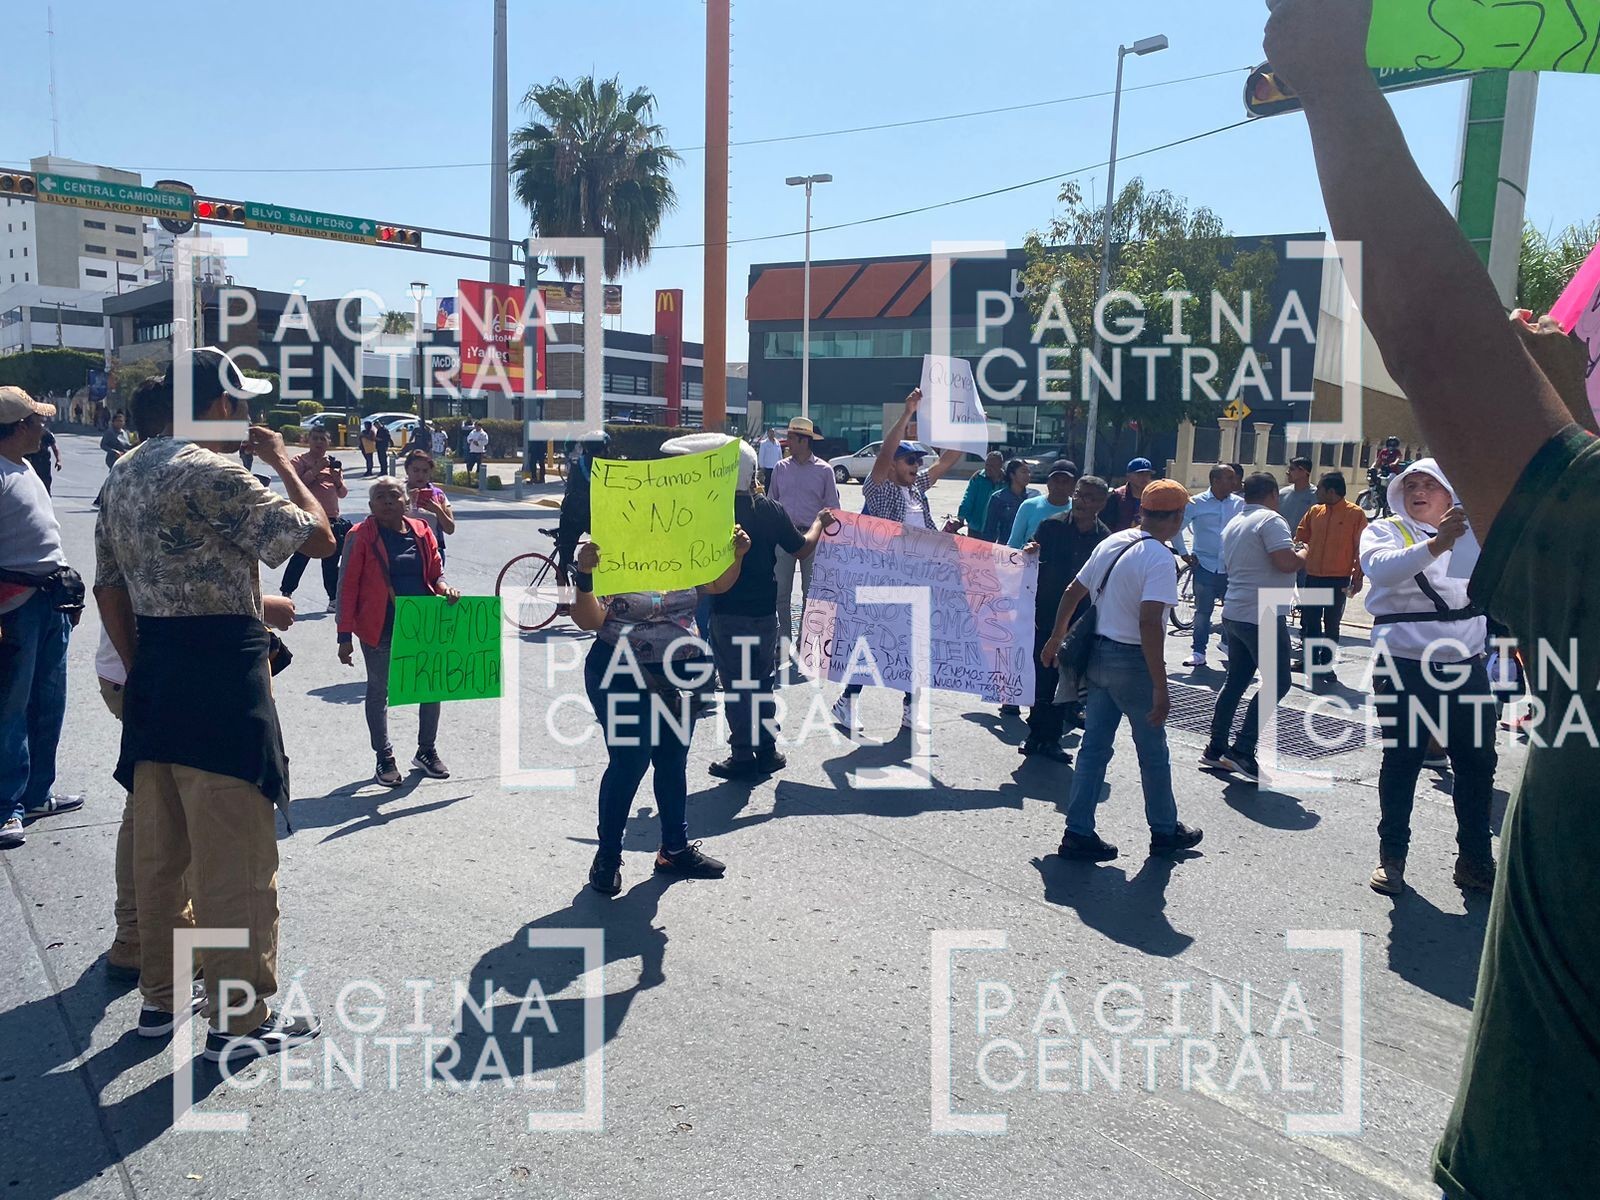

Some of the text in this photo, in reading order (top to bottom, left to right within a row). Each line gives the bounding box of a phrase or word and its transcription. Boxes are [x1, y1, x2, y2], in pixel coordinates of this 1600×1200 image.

[63, 180, 184, 207] CENTRAL CAMIONERA
[46, 194, 178, 218] BLVD. HILARIO MEDINA
[251, 207, 354, 230] BLVD. SAN PEDRO
[598, 552, 682, 574] Estamos
[804, 609, 876, 641] GENTE
[877, 623, 909, 655] DE
[994, 646, 1026, 674] NO
